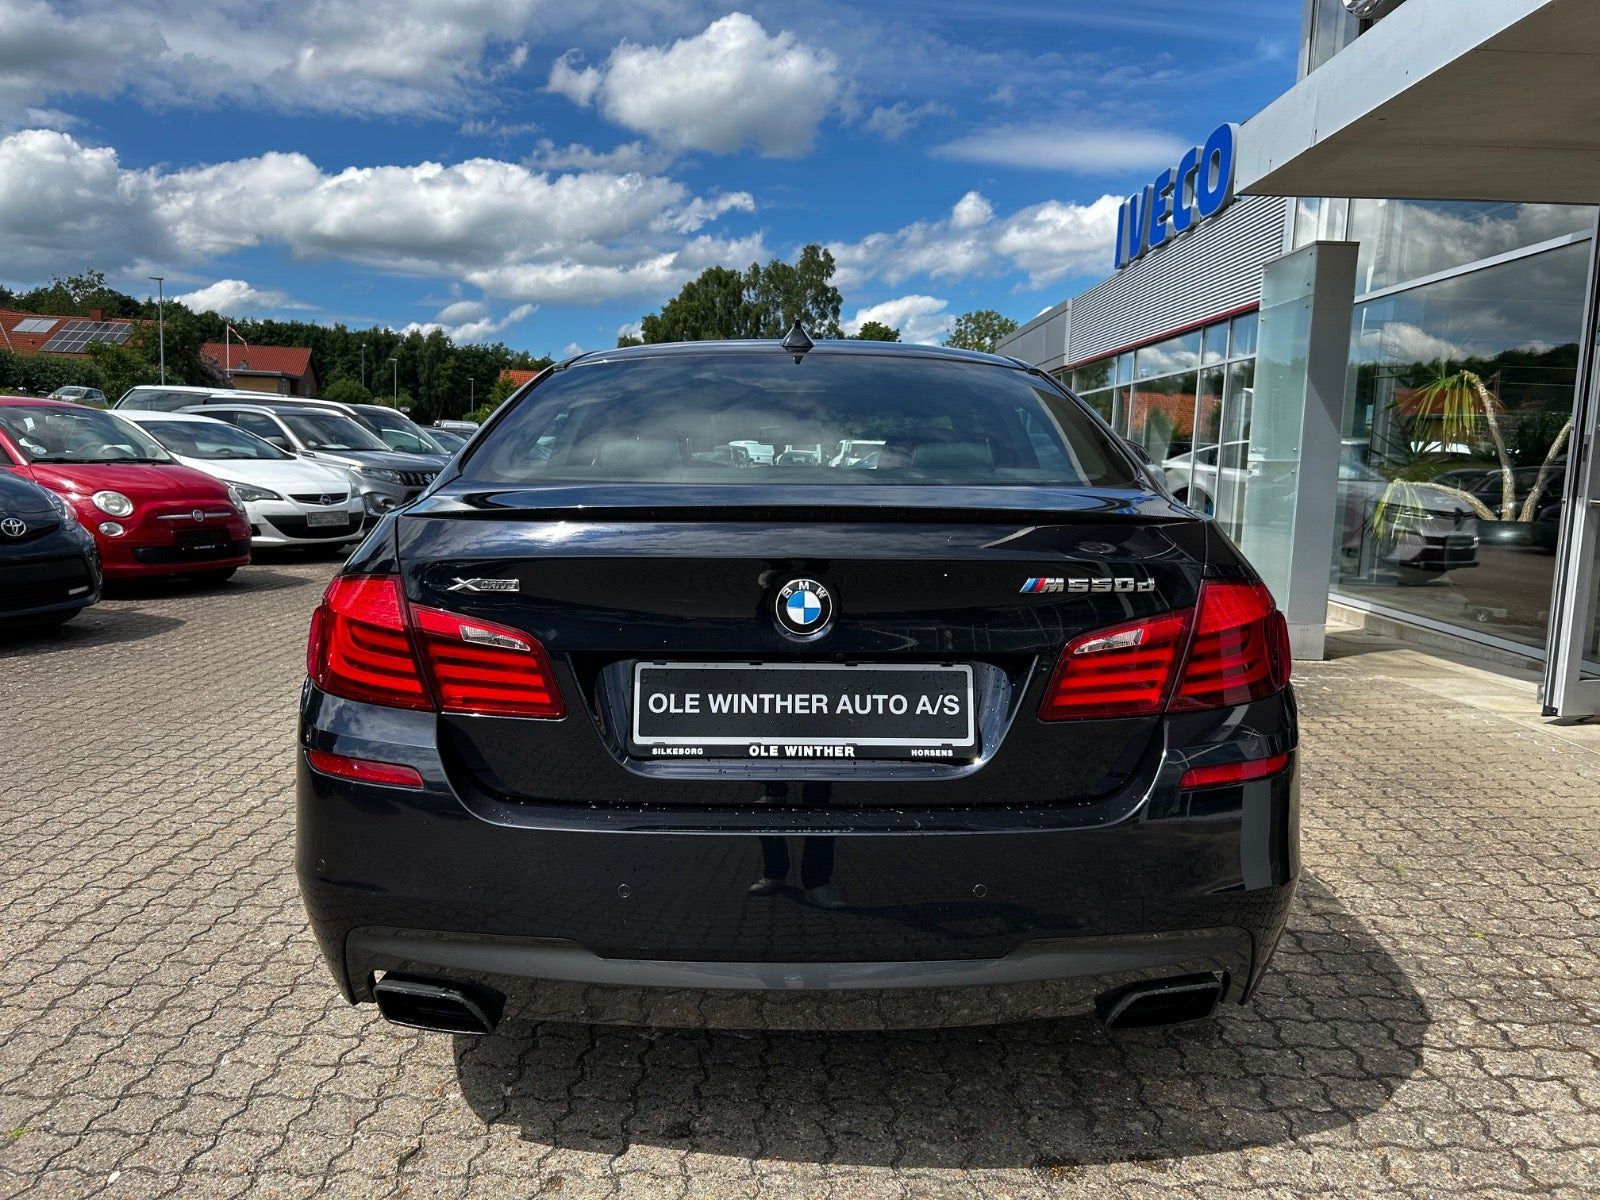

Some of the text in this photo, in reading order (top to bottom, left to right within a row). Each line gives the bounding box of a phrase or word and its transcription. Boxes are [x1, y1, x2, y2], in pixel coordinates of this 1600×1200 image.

[1115, 122, 1238, 269] IVECO
[781, 581, 828, 599] BMW
[1038, 577, 1155, 593] M550d
[648, 692, 960, 716] OLE WINTHER AUTO A/S
[651, 747, 703, 755] SILKEBORG
[749, 745, 855, 758] OLE WINTHER
[911, 749, 954, 757] HORSENS
